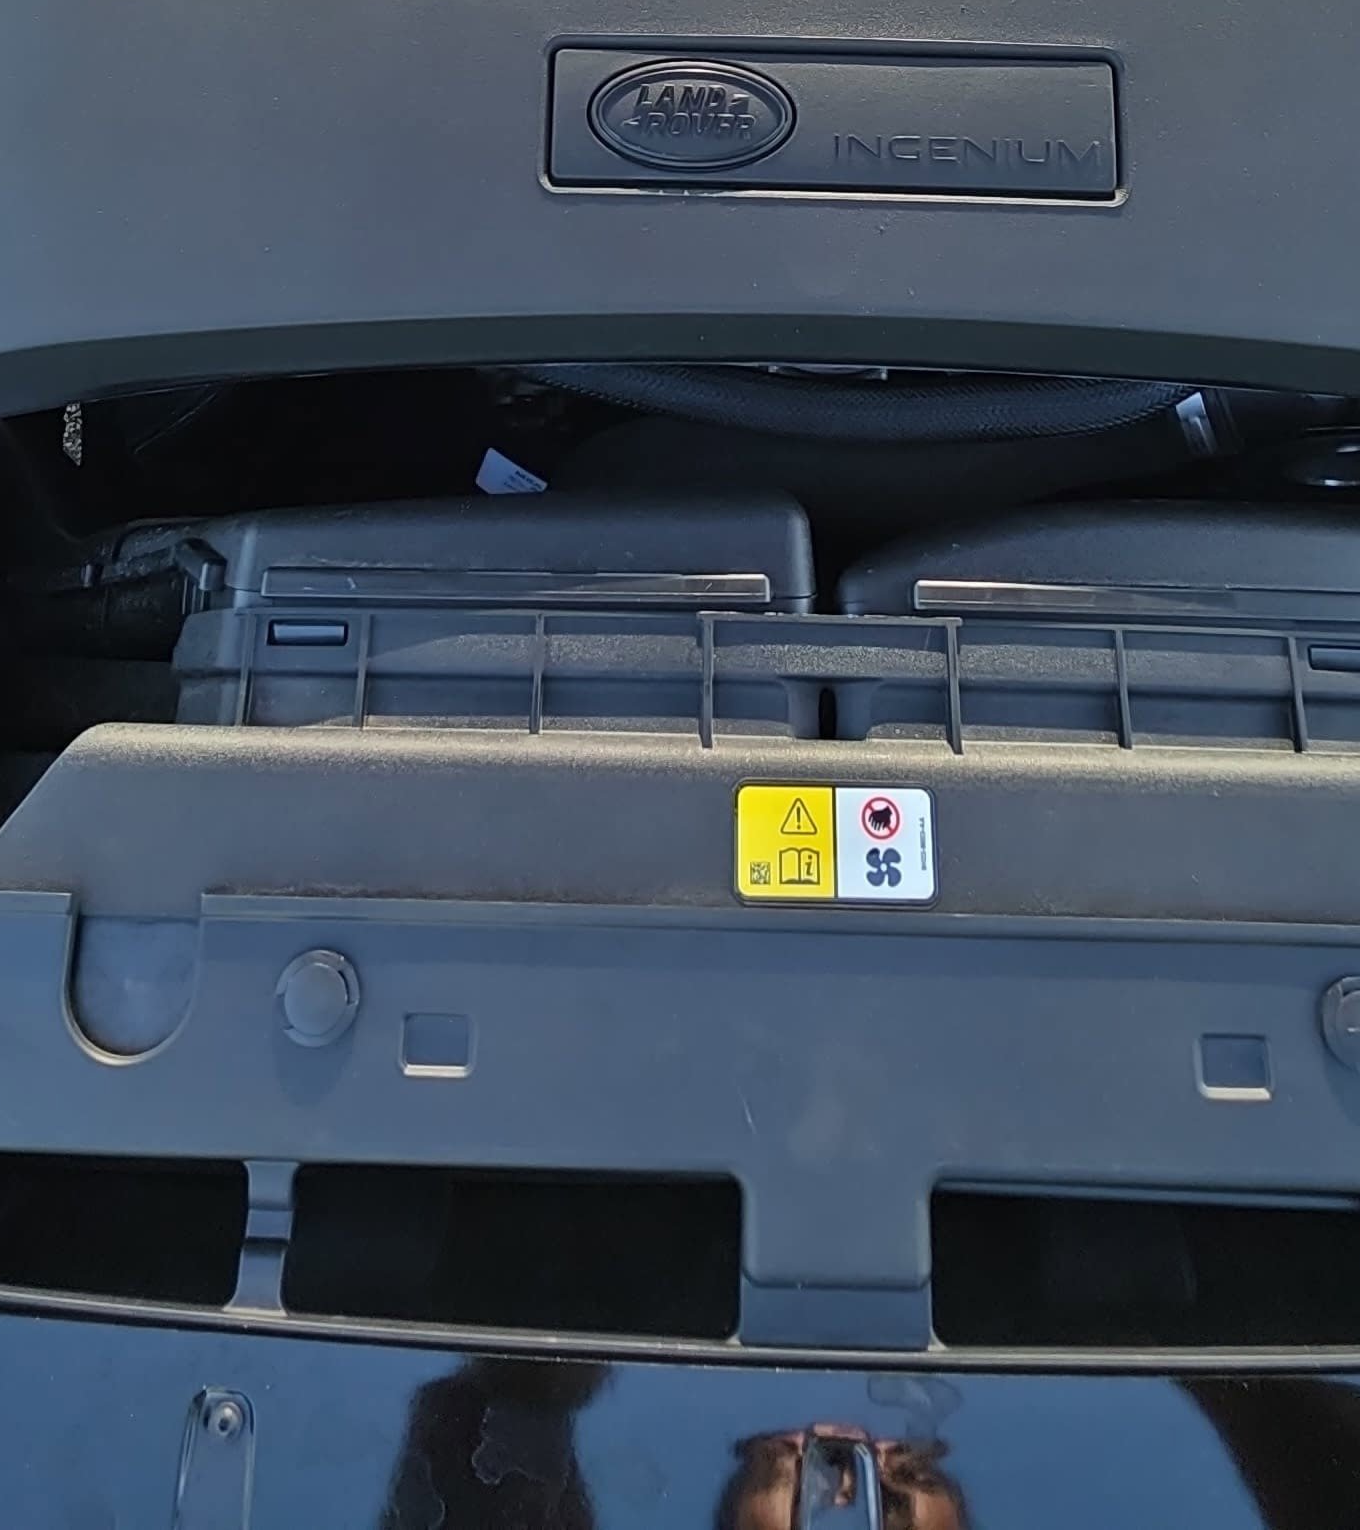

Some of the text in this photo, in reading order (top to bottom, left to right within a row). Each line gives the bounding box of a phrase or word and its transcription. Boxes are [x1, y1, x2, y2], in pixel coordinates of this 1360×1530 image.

[635, 84, 727, 110] LAND
[644, 112, 757, 138] ROVER
[834, 132, 1103, 166] INGENIUM
